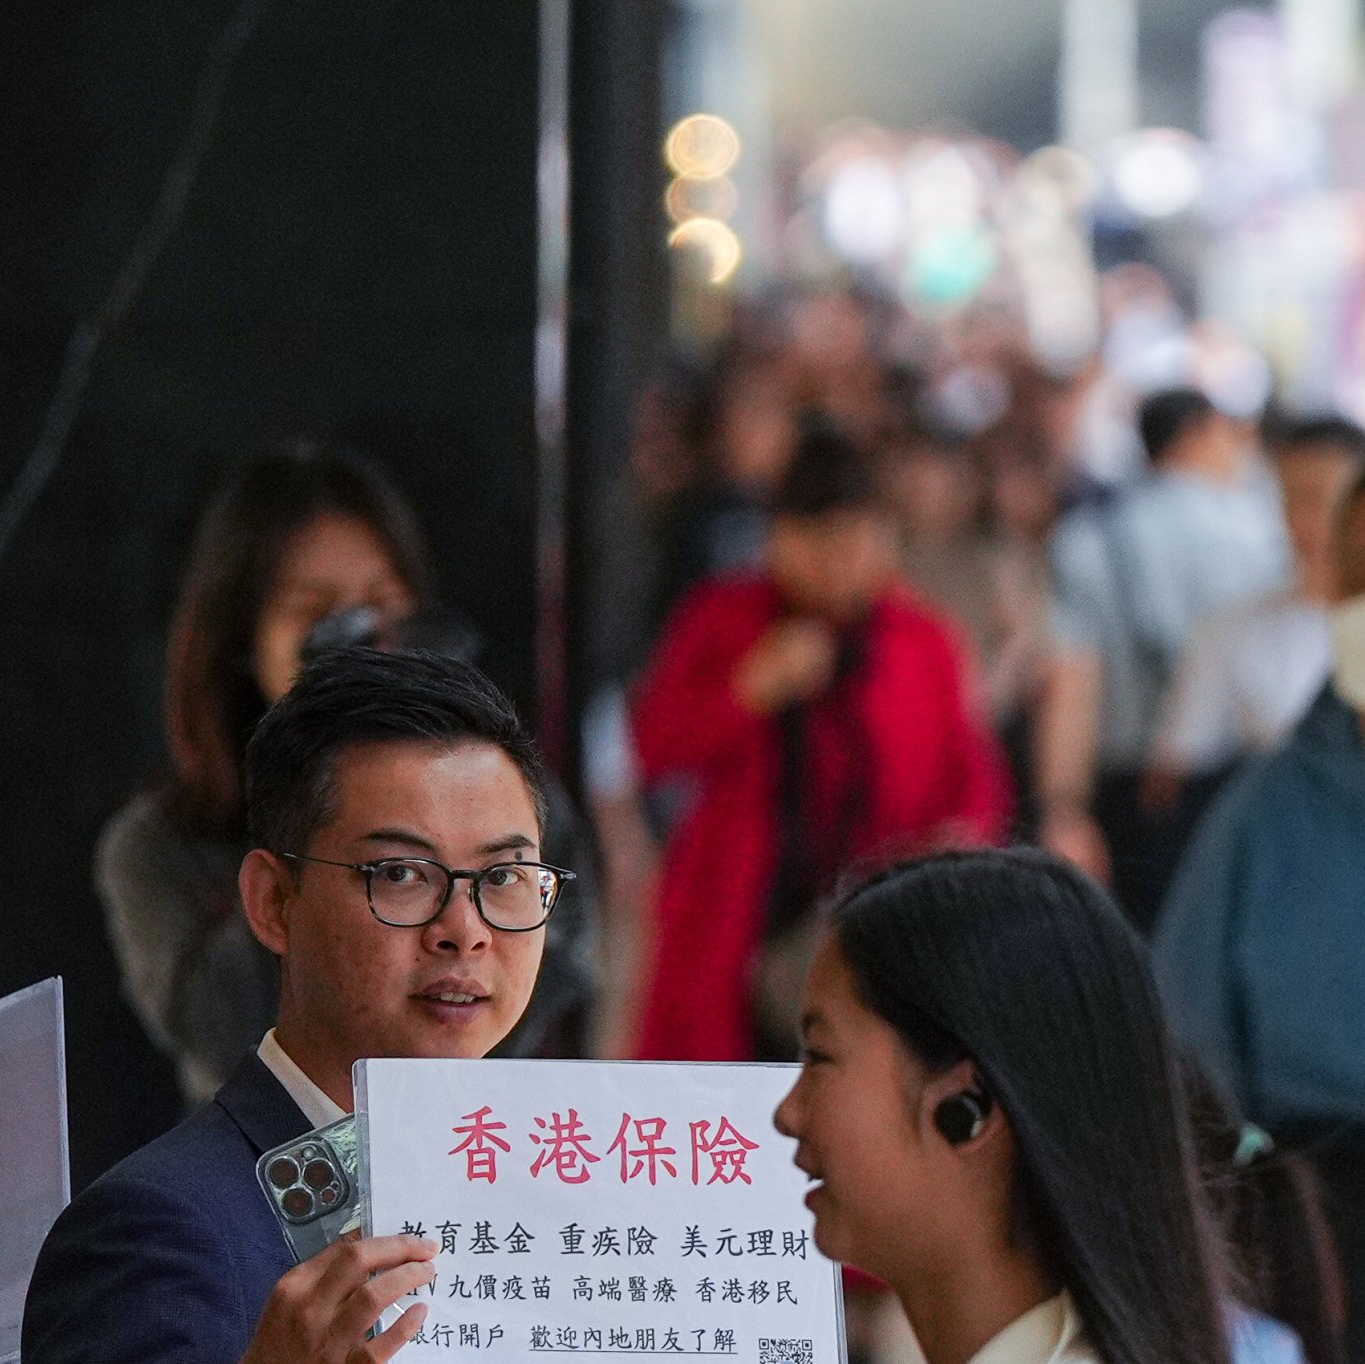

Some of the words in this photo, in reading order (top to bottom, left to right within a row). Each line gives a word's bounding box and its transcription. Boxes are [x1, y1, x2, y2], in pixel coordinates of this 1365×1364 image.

[448, 1105, 760, 1186] 香港保險
[558, 1222, 658, 1257] 重疾險
[680, 1224, 810, 1261] 美元理財
[572, 1274, 678, 1303] 高端醫療
[695, 1277, 798, 1306] 香港移民
[529, 1324, 737, 1351] 歡迎內地朋友了解
